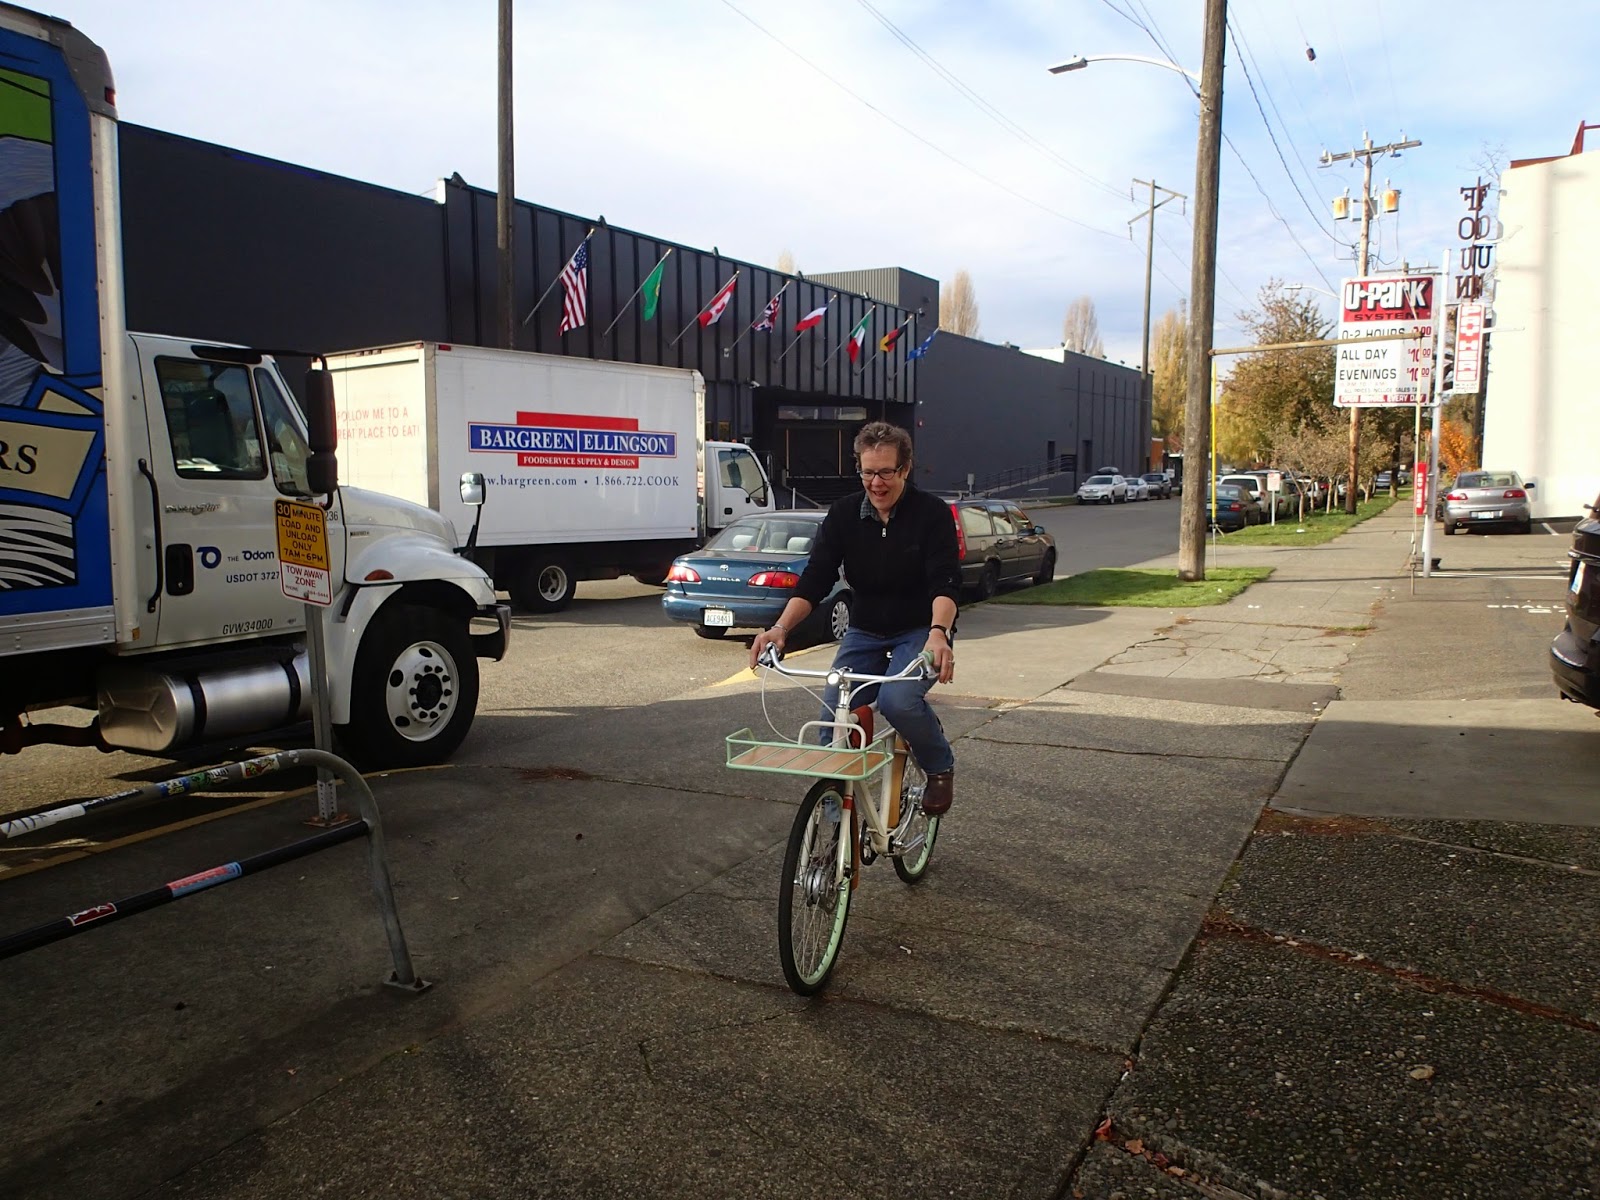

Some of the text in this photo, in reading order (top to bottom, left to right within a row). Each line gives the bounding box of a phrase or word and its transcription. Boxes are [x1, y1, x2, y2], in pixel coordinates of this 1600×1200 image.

[1354, 311, 1420, 321] SYSTEM
[1341, 350, 1360, 360] ALL
[1365, 349, 1388, 360] DAY
[1339, 368, 1397, 381] EVENINGS
[337, 405, 409, 422] FOLLOW ME TO A
[337, 424, 420, 441] REAT PLACE TO EAT!
[480, 429, 668, 453] BARGREEN ELLINGSON
[523, 456, 576, 465] FOODSERVICE
[577, 457, 602, 466] SUPPLY
[610, 458, 636, 466] DESIGN
[484, 474, 577, 489] w.bargreen.com
[595, 475, 680, 486] 1.866.722.COOK
[277, 503, 290, 516] 30
[281, 519, 321, 534] LOAD AND
[286, 529, 318, 543] UNLOAD
[292, 540, 313, 552] ONLY
[241, 550, 275, 561] Odom
[226, 572, 259, 584] USDOT
[286, 564, 324, 580] TOW AWAY
[295, 576, 317, 588] ZONE
